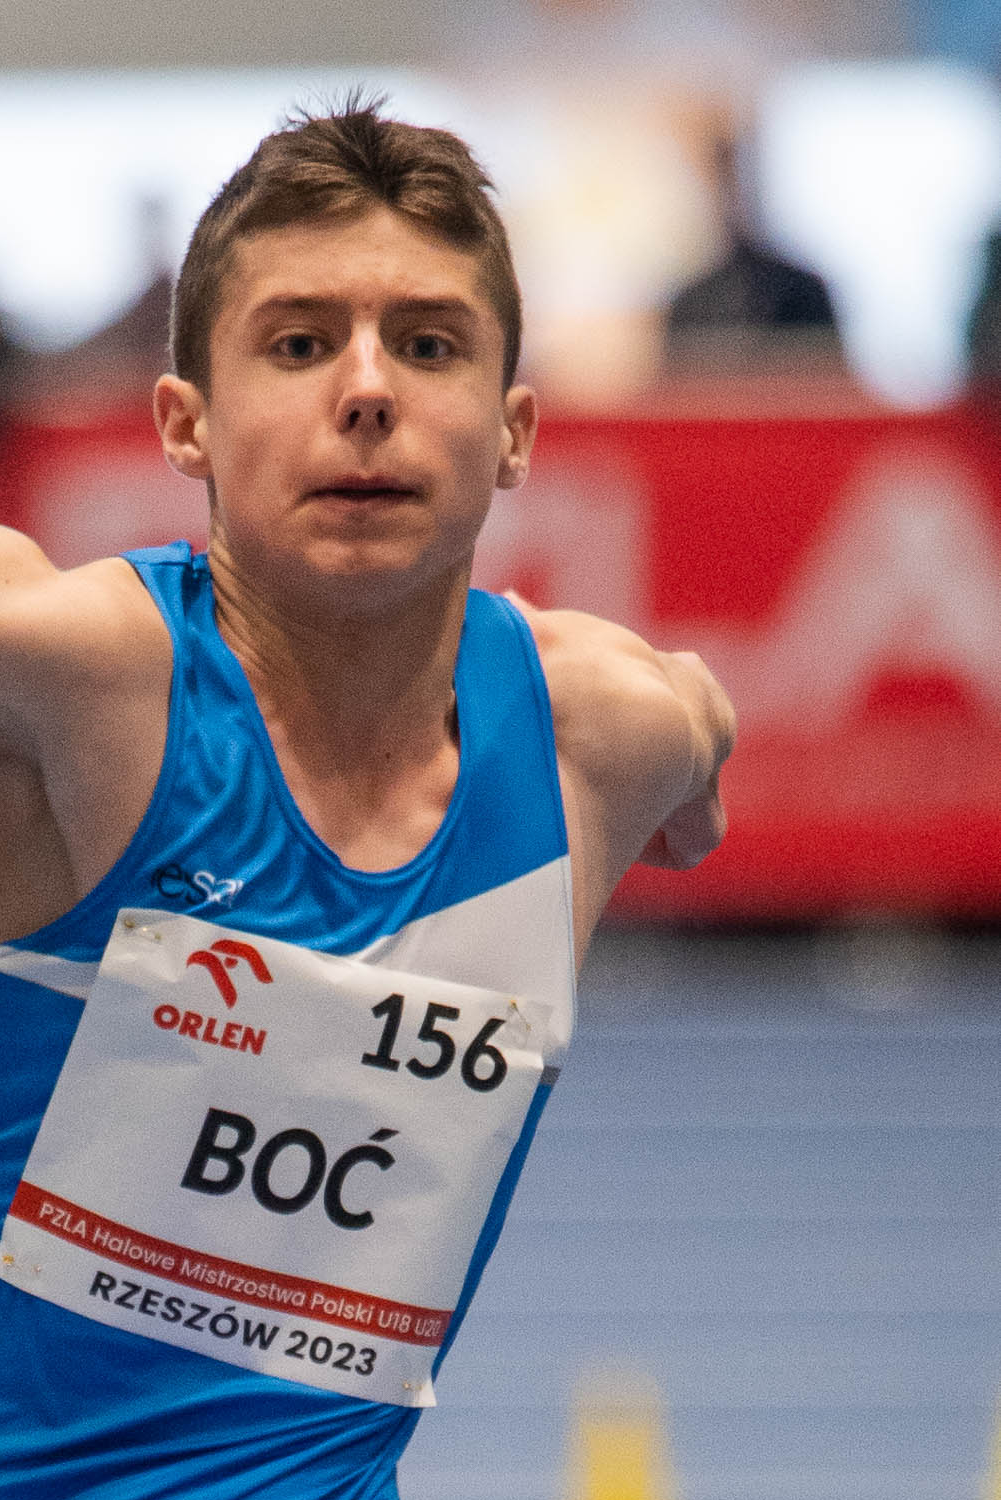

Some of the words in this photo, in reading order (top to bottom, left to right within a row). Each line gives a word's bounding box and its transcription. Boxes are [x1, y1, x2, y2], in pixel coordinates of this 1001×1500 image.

[153, 1004, 267, 1056] ORLEN
[361, 993, 508, 1092] 156
[180, 1107, 400, 1231] BOĆ
[39, 1202, 87, 1239] PZLA
[92, 1227, 175, 1270] Halowe
[180, 1258, 306, 1307] Mistrzostwa
[310, 1292, 375, 1325] Polski
[378, 1309, 412, 1333] U18
[88, 1270, 280, 1351] RZESZÓW
[285, 1330, 377, 1377] 2023
